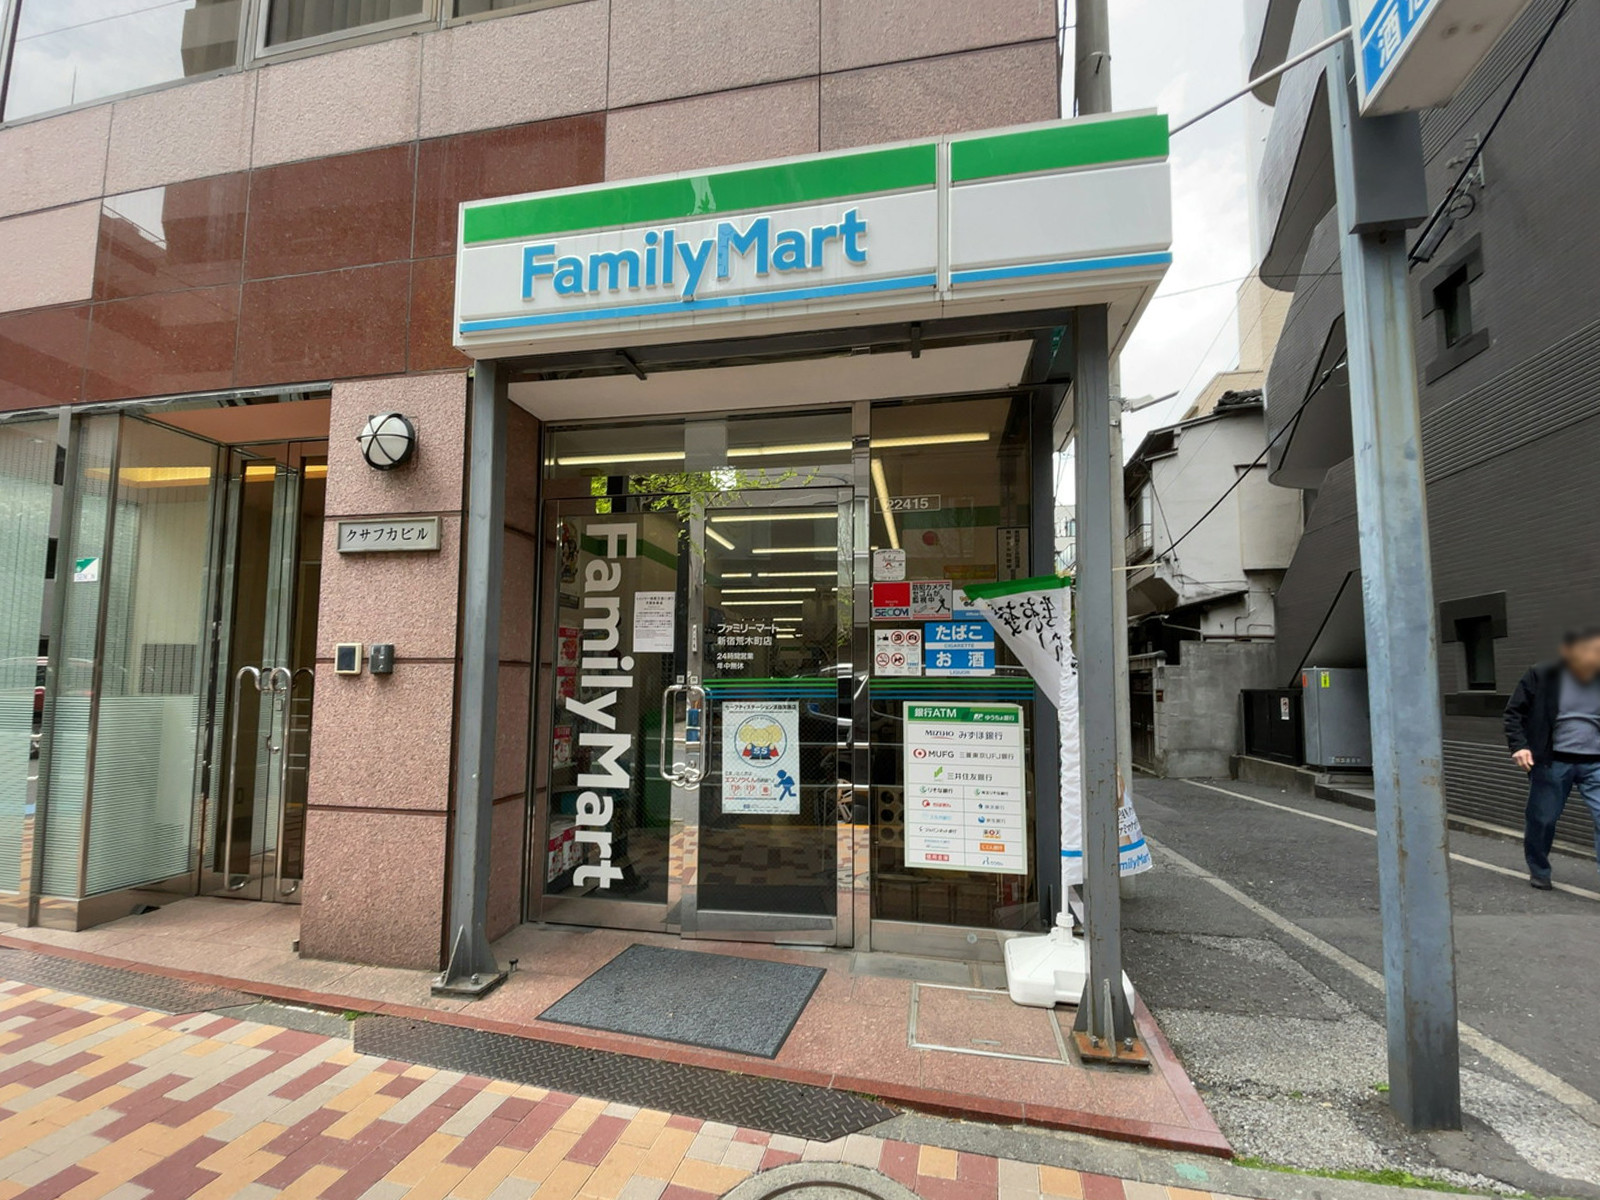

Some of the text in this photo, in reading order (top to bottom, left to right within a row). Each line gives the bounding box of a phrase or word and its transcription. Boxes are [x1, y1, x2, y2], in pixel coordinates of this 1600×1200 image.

[521, 206, 868, 302] FamilyMart
[346, 527, 429, 542] クサフカビル
[875, 608, 910, 617] SECOM
[717, 624, 779, 633] ファミリーマート
[936, 625, 983, 640] たばこ
[717, 636, 772, 646] 新宿荒木町店
[717, 652, 754, 660] 24時間営業
[565, 522, 637, 889] FamilyMart
[914, 707, 957, 718] 銀行ATM
[958, 731, 1003, 740] みずほ銀行
[928, 750, 954, 759] MUFG
[947, 772, 993, 782] 三井住友銀行
